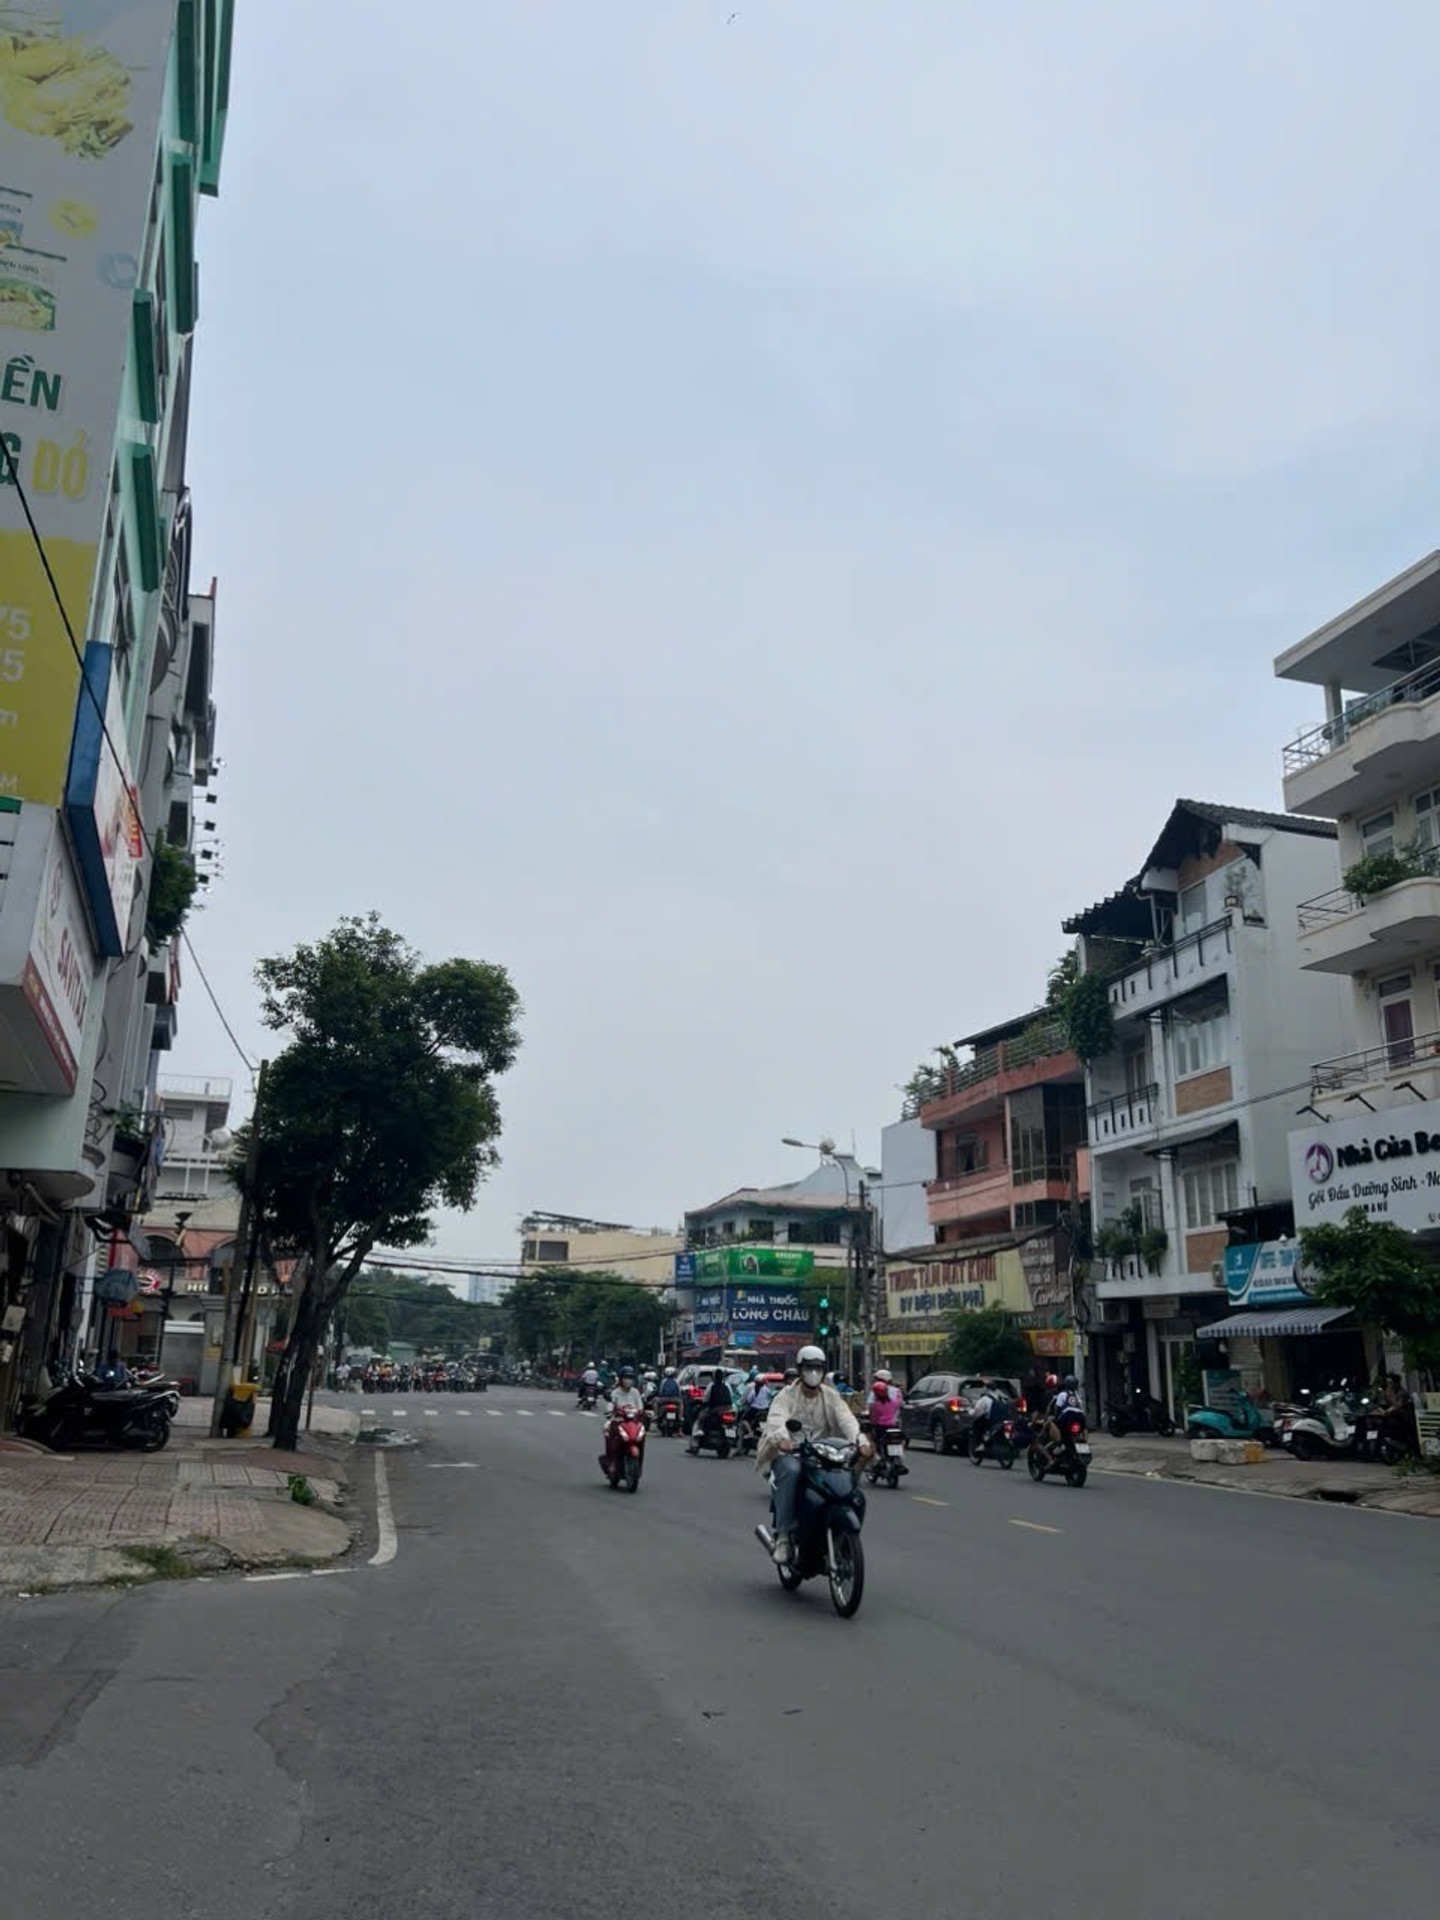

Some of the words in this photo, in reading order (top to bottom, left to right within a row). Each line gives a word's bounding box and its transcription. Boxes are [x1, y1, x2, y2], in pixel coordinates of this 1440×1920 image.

[1337, 1137, 1373, 1168] Nhà
[1374, 1134, 1413, 1160] Của
[1391, 1175, 1417, 1192] Sinh
[747, 1294, 765, 1304] NHÀ
